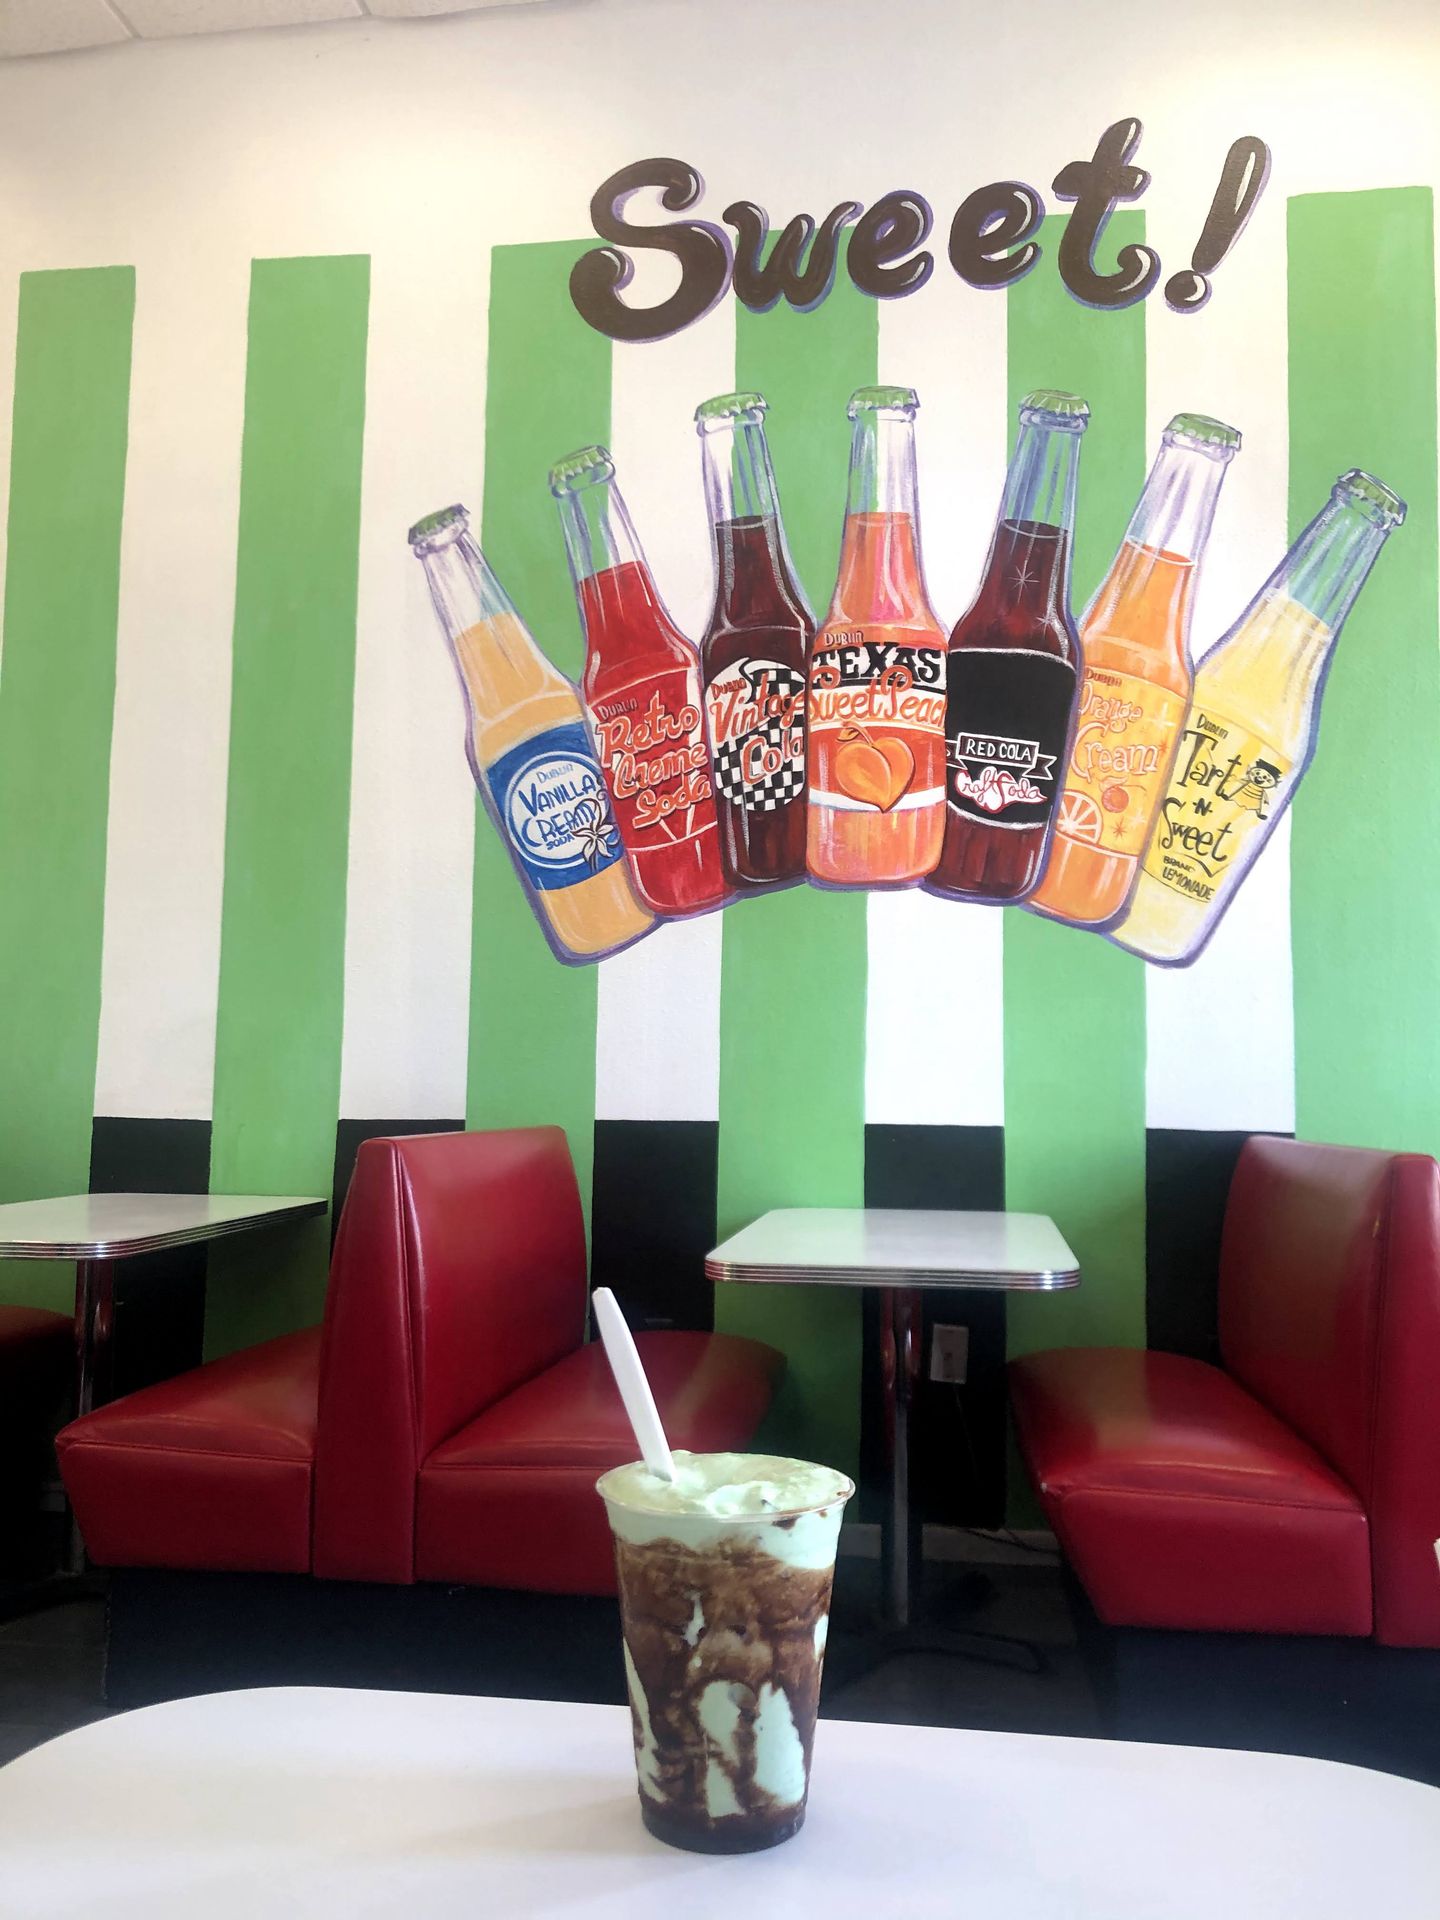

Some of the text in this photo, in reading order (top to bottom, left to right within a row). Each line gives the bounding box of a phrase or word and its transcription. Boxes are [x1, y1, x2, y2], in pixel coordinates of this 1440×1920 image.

[568, 117, 1271, 343] Sweet!
[812, 642, 941, 683] TEXAS
[708, 672, 805, 744] Vintage
[880, 665, 947, 728] Peac
[1079, 681, 1143, 733] Orange
[596, 690, 700, 769] Retro
[741, 729, 805, 785] Cola
[966, 739, 996, 758] RED
[999, 743, 1032, 762] COLA
[1070, 720, 1159, 784] Cream
[612, 743, 708, 799] Creme
[1176, 730, 1242, 801] Tart
[518, 774, 597, 817] VANILLA
[631, 773, 713, 829] Soda
[521, 802, 597, 848] CREAM
[545, 833, 575, 851] SODA
[1161, 797, 1232, 862] Sweet
[1162, 866, 1215, 900] LEMONADE
